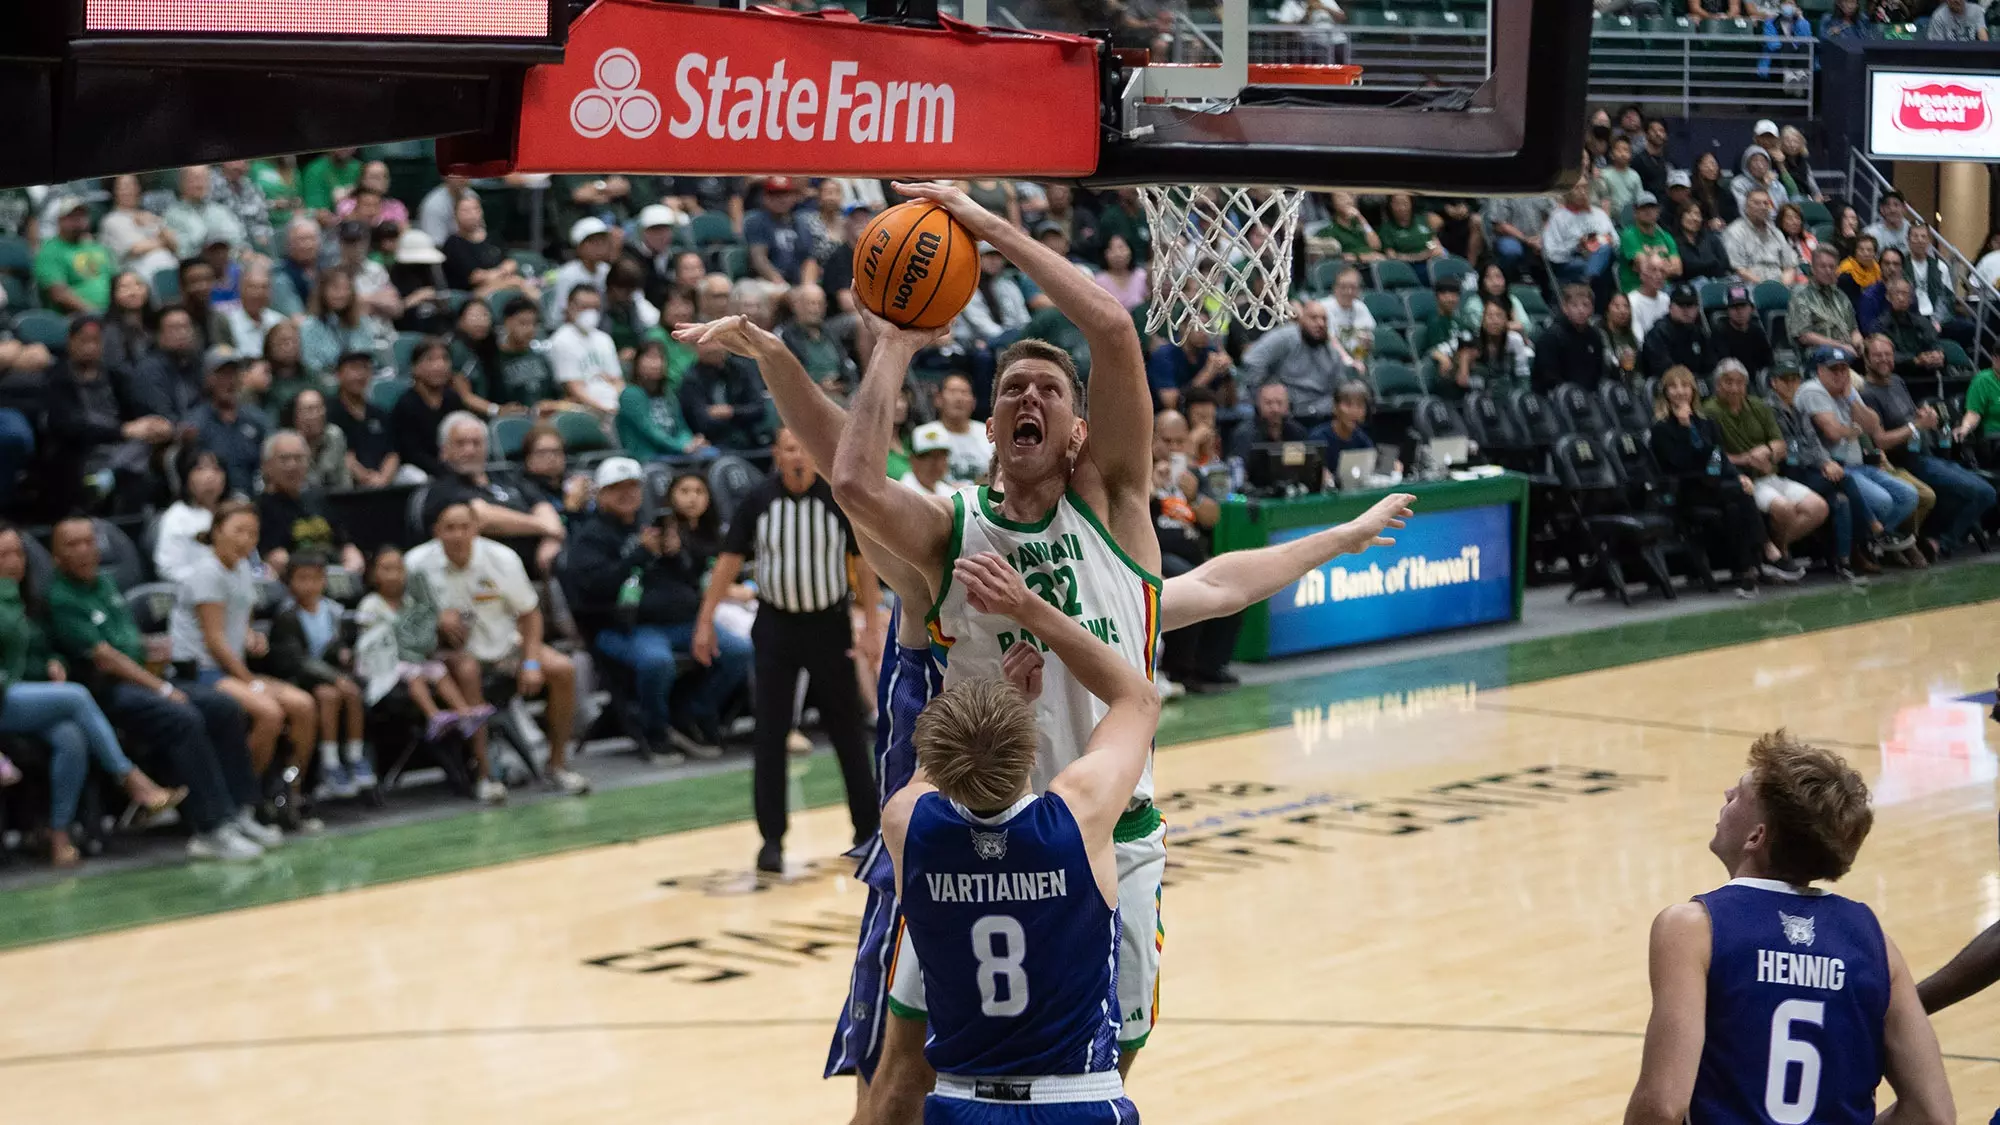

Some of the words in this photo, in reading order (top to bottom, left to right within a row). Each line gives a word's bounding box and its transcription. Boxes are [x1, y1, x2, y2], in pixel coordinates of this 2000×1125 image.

[1919, 105, 1966, 123] Gold
[892, 231, 942, 310] Wilson
[1330, 562, 1384, 602] Bank
[1385, 556, 1409, 594] of
[925, 869, 1067, 902] VARTIAINEN
[971, 915, 1030, 1017] 8
[1757, 949, 1846, 991] HENNIG
[1765, 999, 1826, 1125] 6
